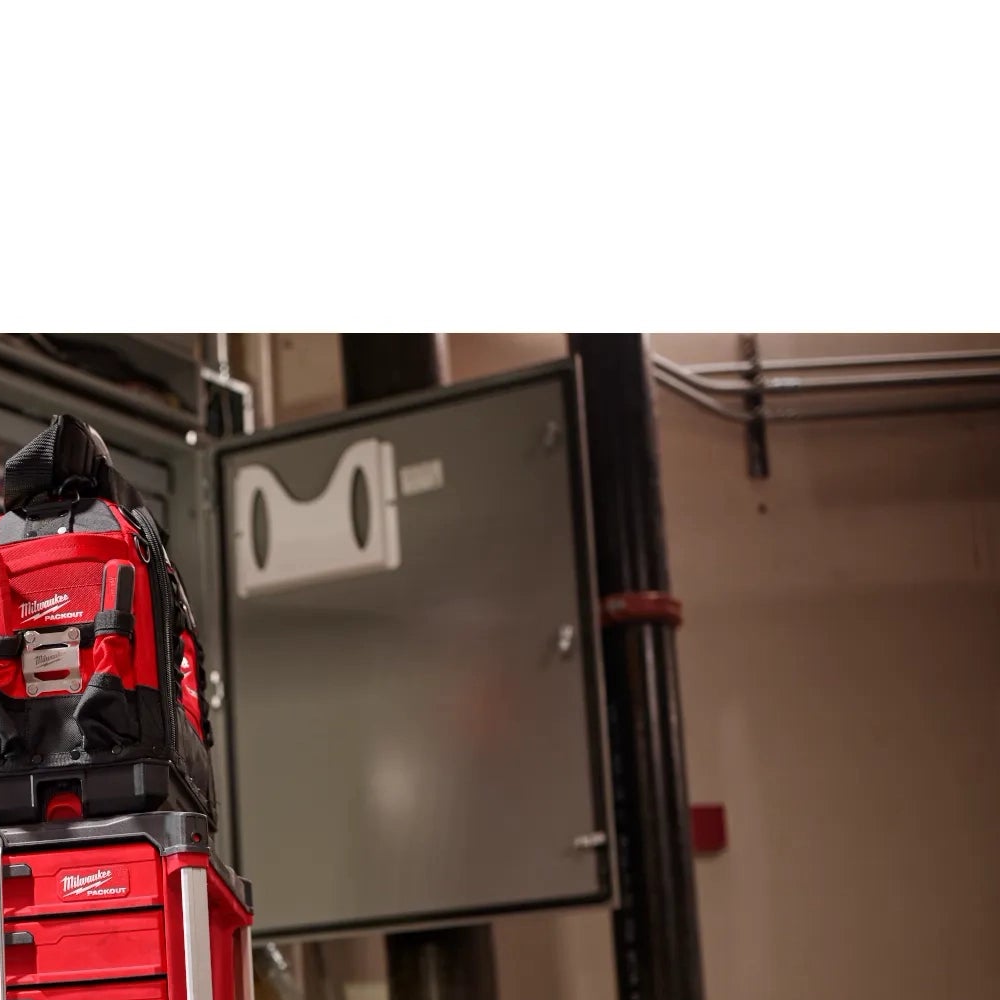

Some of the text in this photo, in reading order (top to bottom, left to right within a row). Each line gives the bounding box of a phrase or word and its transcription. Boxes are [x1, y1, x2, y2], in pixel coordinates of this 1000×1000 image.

[18, 593, 69, 618] Milwaukee
[44, 611, 84, 621] PACKOUT
[60, 869, 112, 892] Milwaukee
[86, 887, 127, 897] PACKOUT
